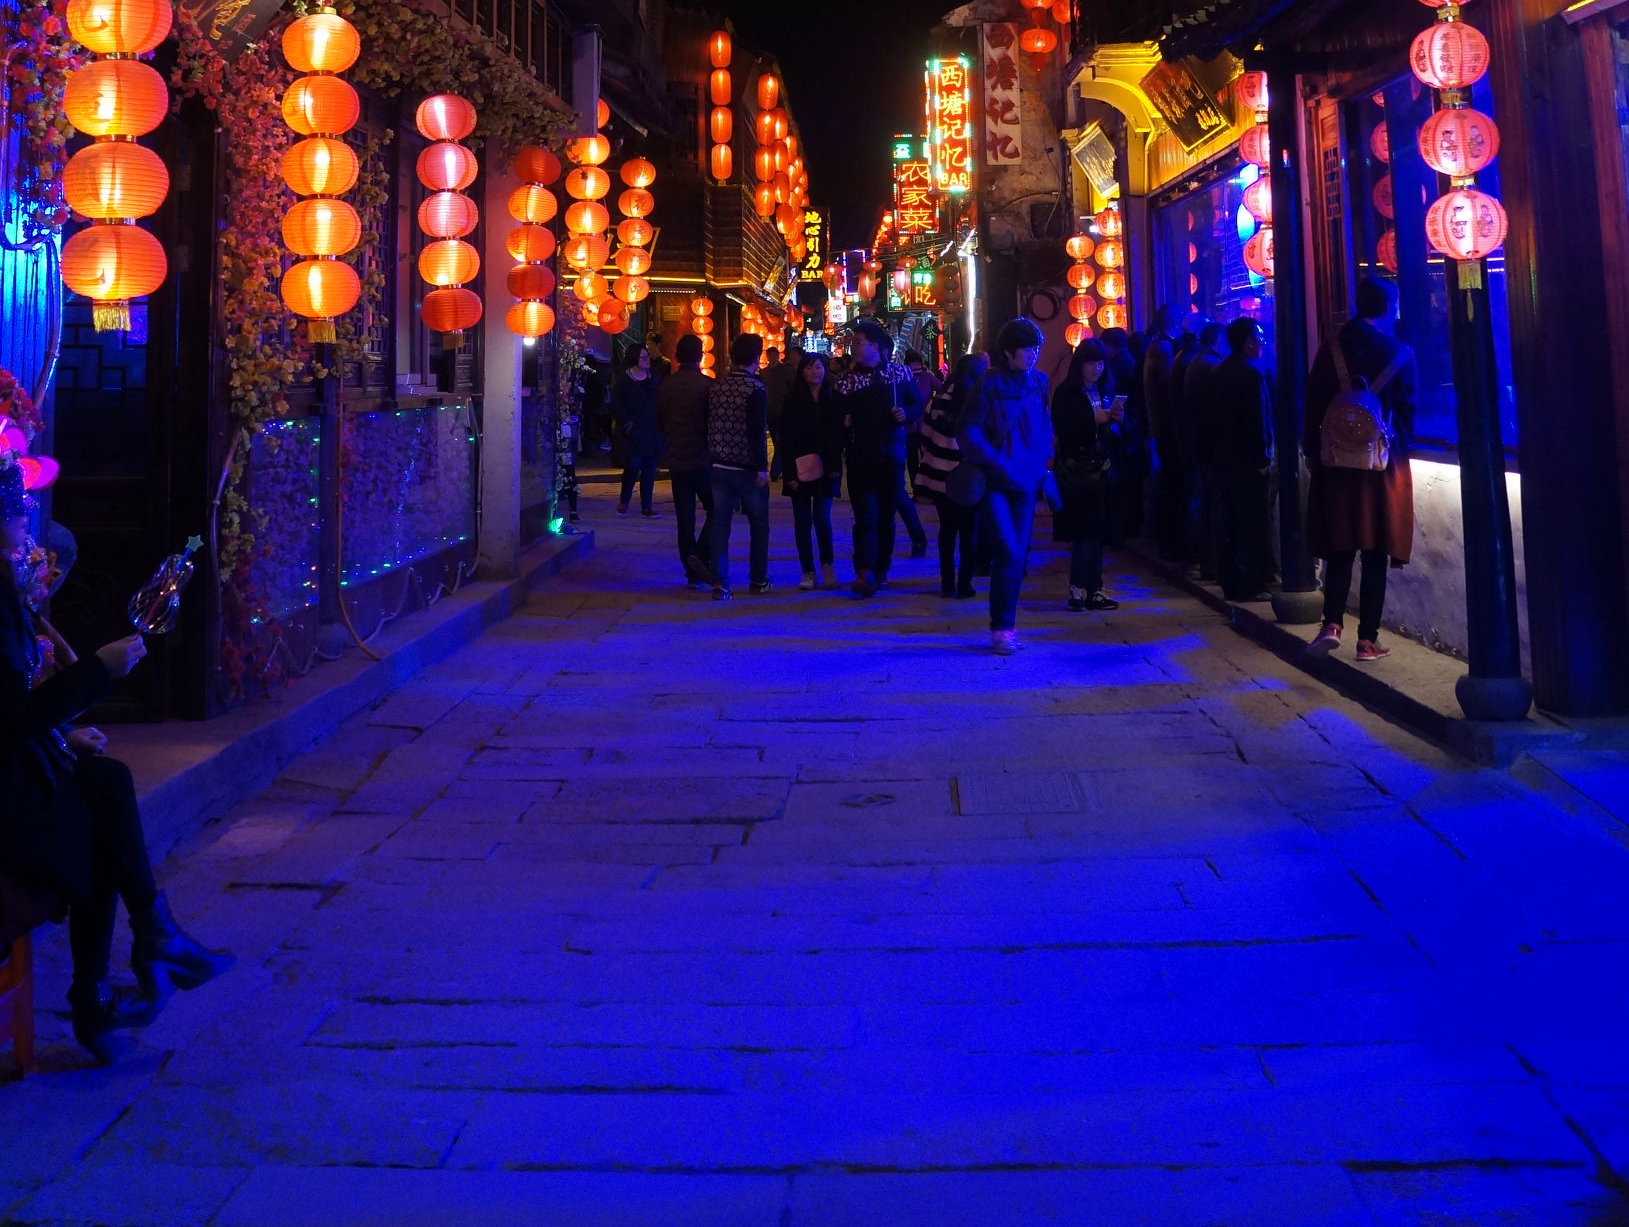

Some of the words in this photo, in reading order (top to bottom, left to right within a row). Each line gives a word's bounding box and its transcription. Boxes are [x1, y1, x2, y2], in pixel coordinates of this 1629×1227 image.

[940, 65, 966, 169] 西塘记忆
[900, 161, 933, 230] 农家菜
[940, 173, 968, 185] BAR
[804, 210, 822, 269] 地心引力
